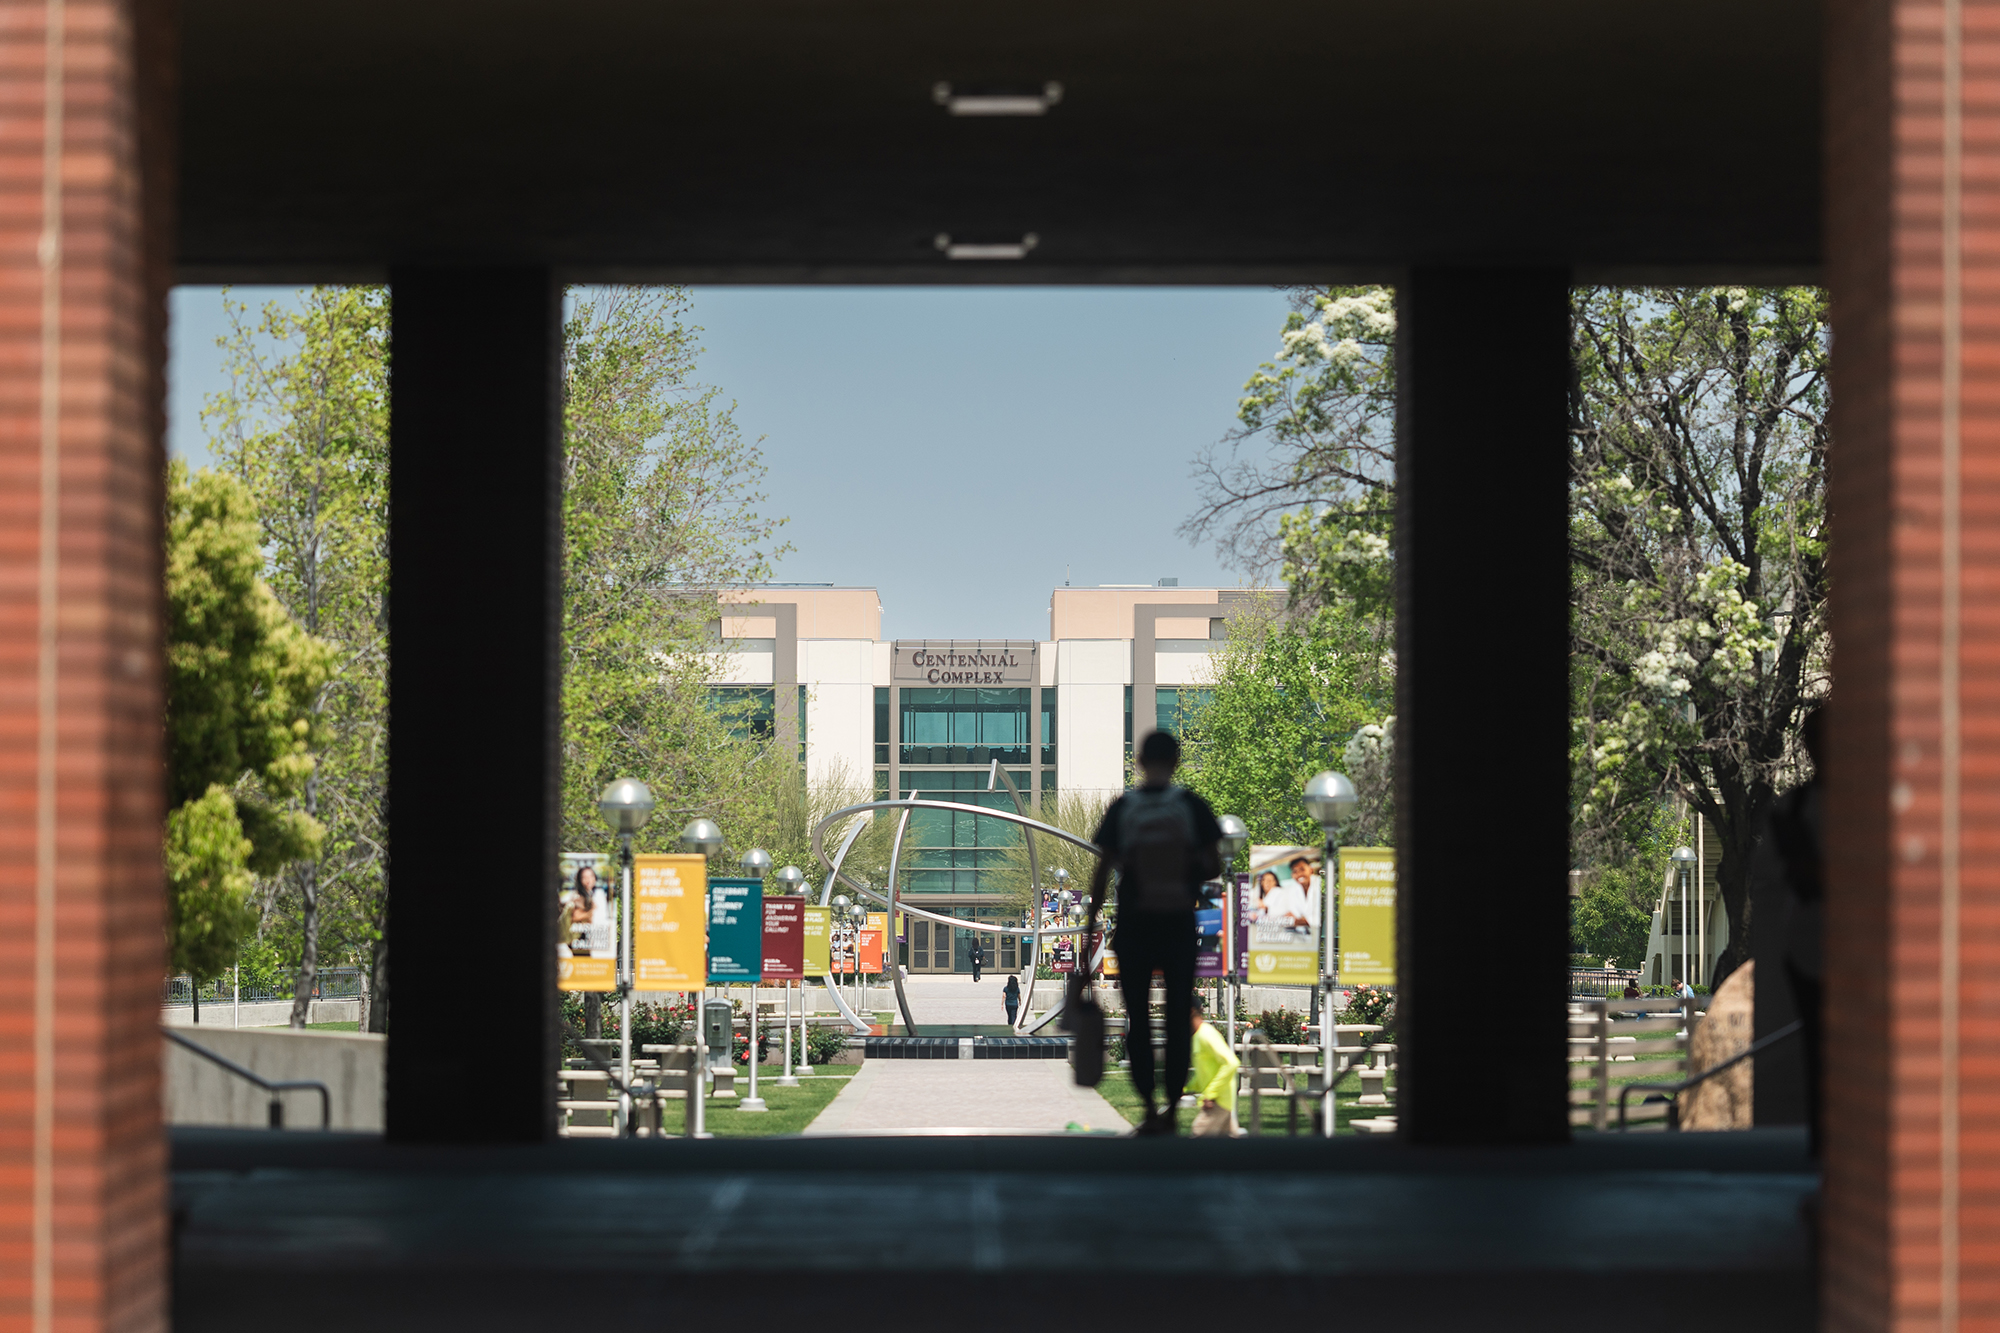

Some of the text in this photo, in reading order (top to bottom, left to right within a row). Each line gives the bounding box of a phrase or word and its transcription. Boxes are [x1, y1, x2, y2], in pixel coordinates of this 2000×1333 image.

[912, 651, 1019, 667] CENTENNIAL
[927, 668, 1004, 684] COMPLEX
[1344, 861, 1394, 870] YOU FOUND
[1344, 870, 1367, 880] YOUR
[1344, 886, 1379, 896] THANKS
[1343, 896, 1370, 907] BEING
